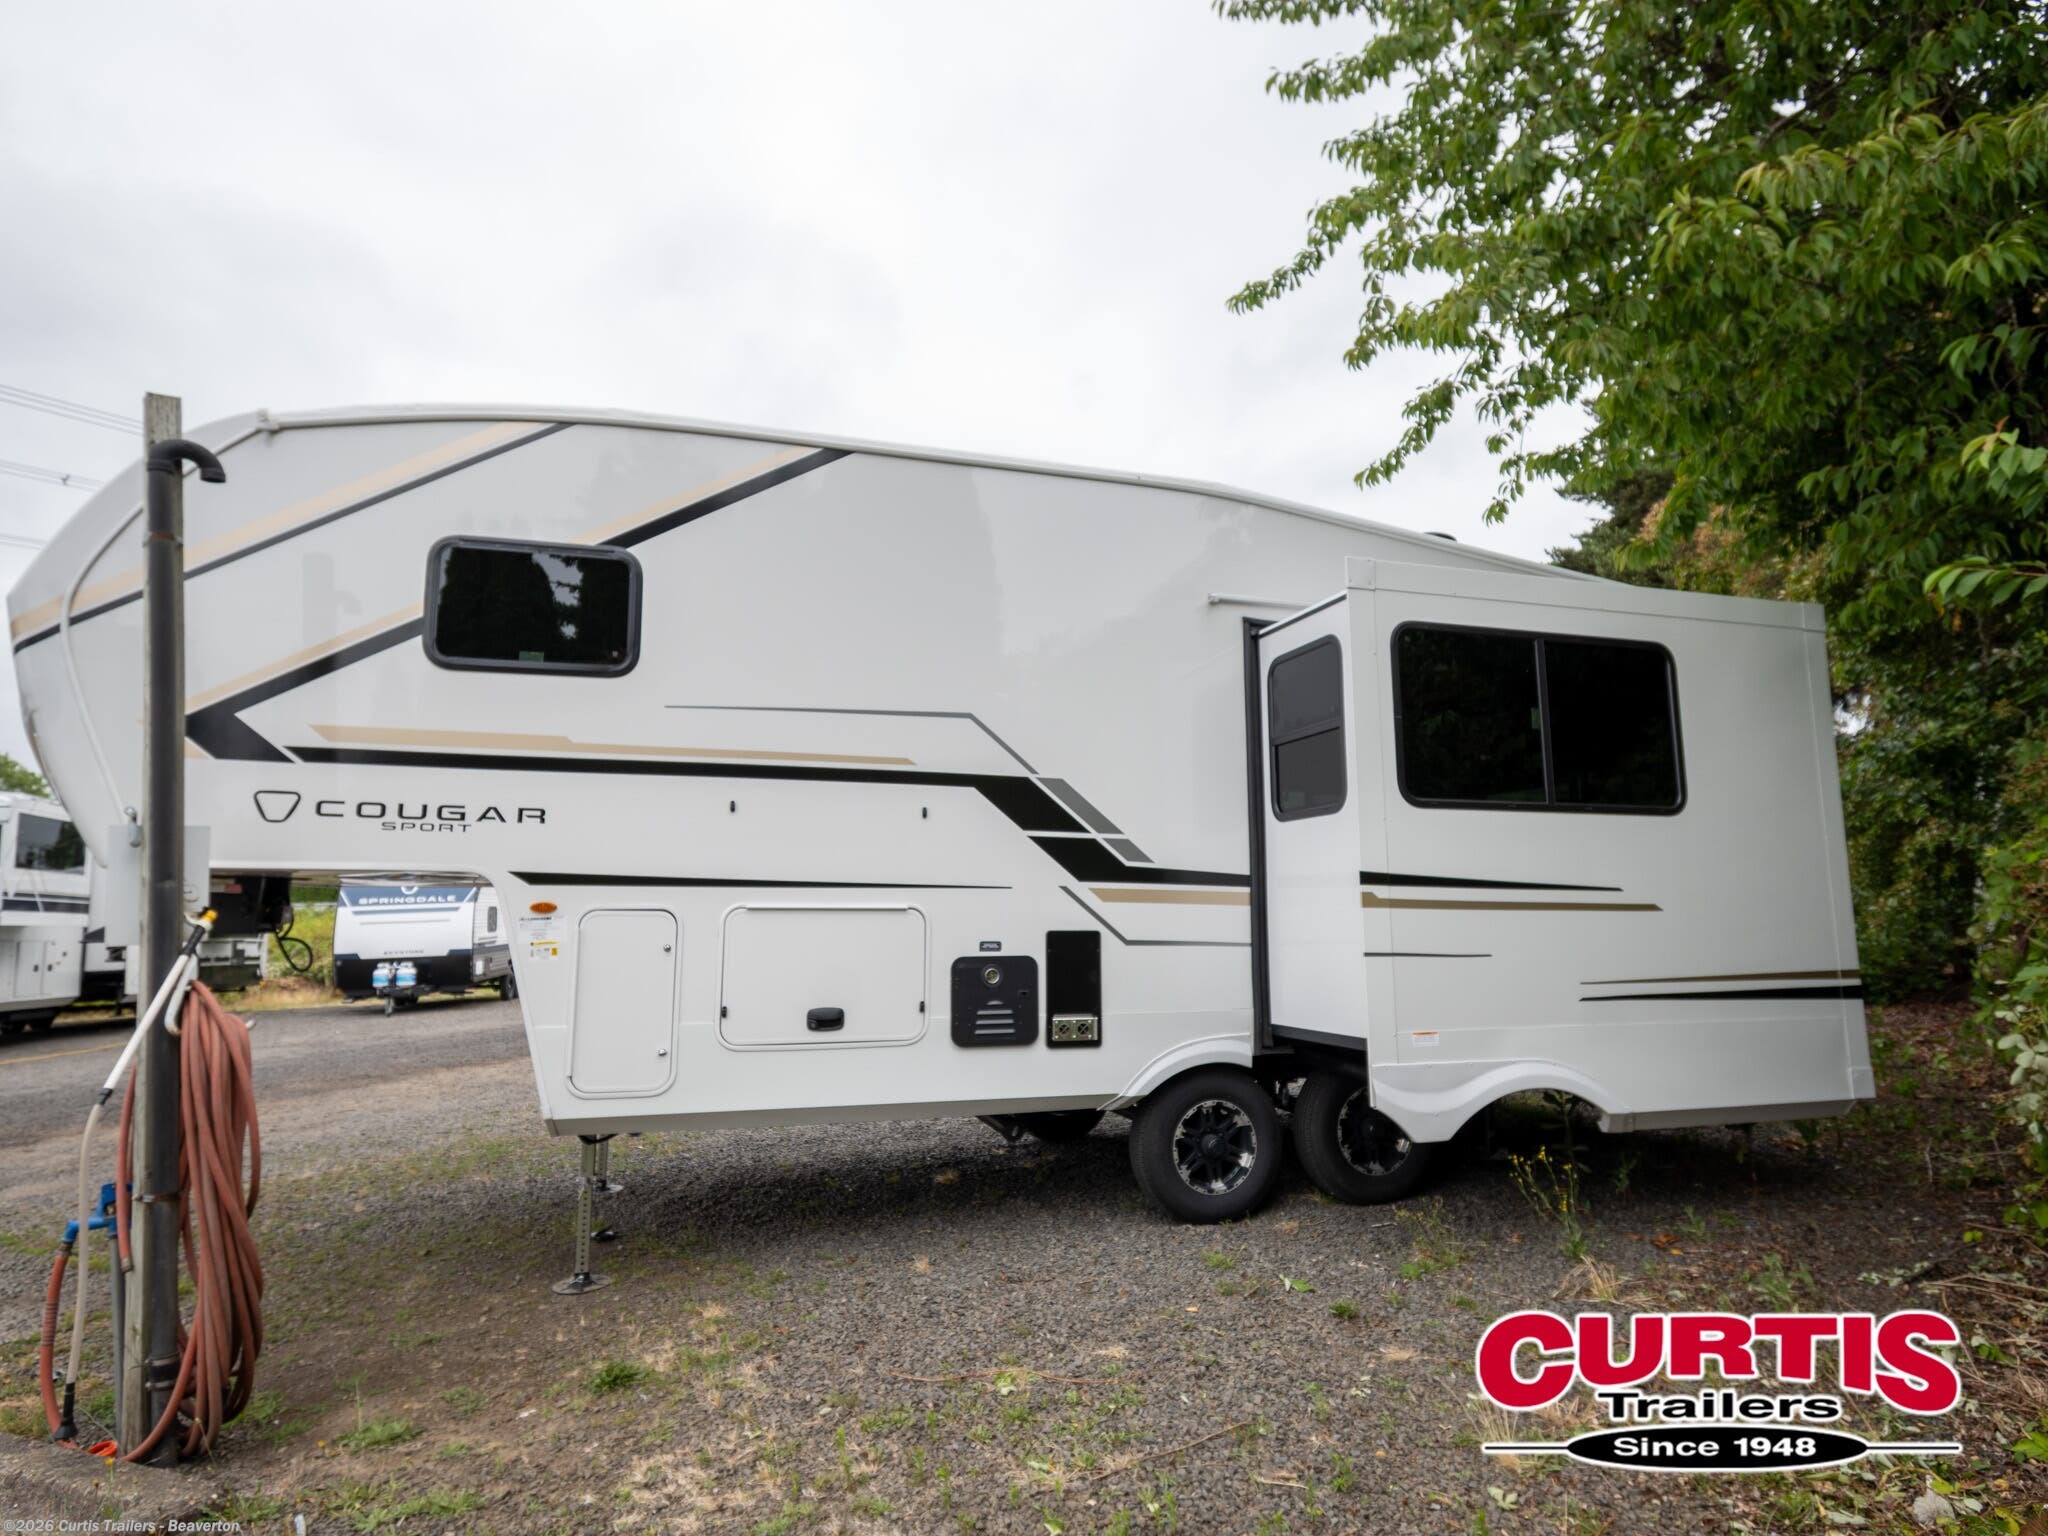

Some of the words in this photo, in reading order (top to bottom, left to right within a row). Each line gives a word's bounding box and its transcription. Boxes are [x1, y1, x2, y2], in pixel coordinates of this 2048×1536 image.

[315, 800, 547, 824] COUGAR
[381, 821, 472, 833] SPORT
[358, 895, 457, 905] SPRINGDALE
